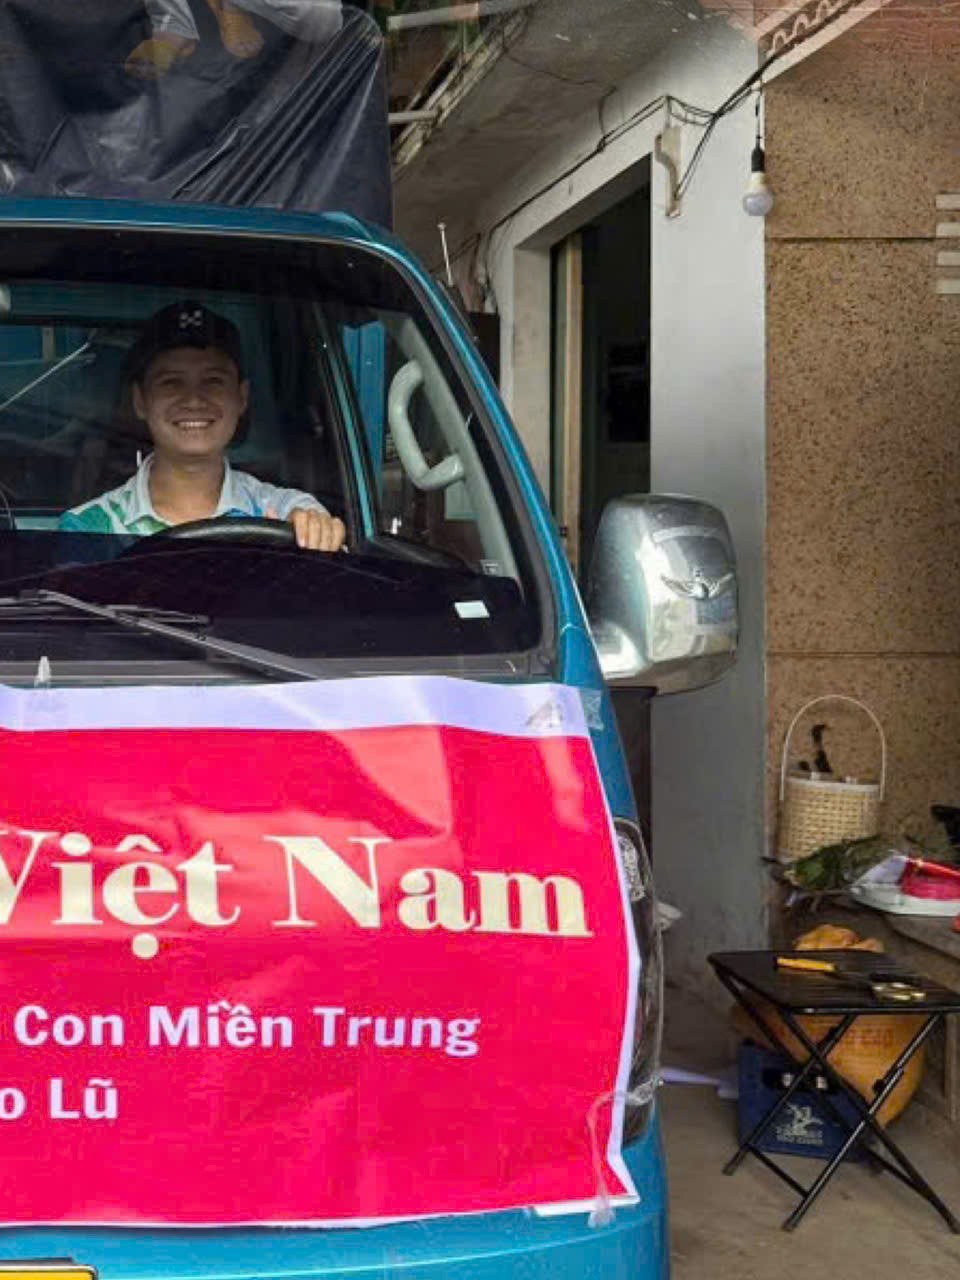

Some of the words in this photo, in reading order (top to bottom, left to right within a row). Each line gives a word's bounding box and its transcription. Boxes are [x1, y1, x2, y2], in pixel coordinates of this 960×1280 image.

[263, 835, 593, 938] Nam
[14, 1004, 125, 1046] Con
[148, 1000, 294, 1048] Miền
[313, 1006, 481, 1057] Trung
[49, 1077, 118, 1120] Lũ
